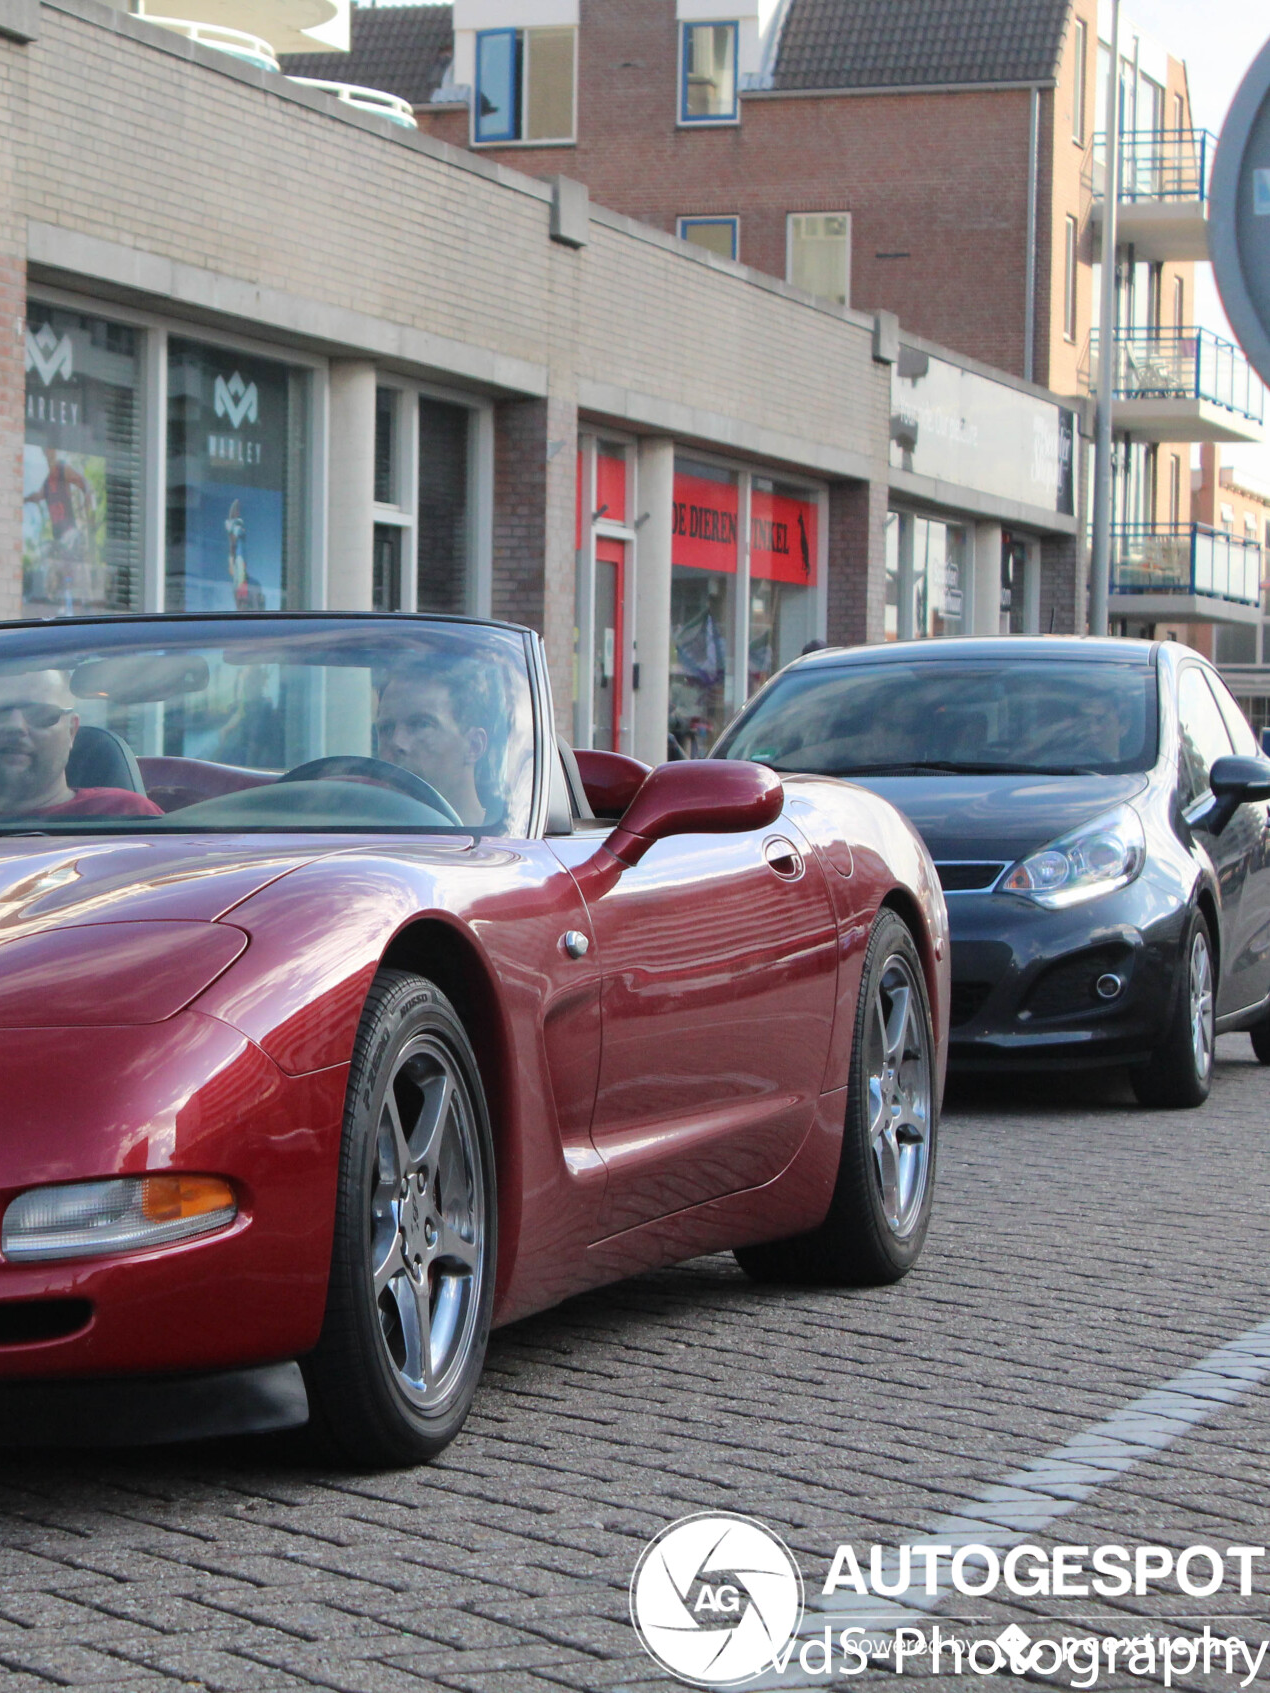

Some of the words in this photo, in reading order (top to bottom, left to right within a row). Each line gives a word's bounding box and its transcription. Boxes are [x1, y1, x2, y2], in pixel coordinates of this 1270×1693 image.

[27, 394, 78, 425] ARLEY
[208, 435, 261, 464] MARLEY
[400, 993, 428, 1019] ROSSO
